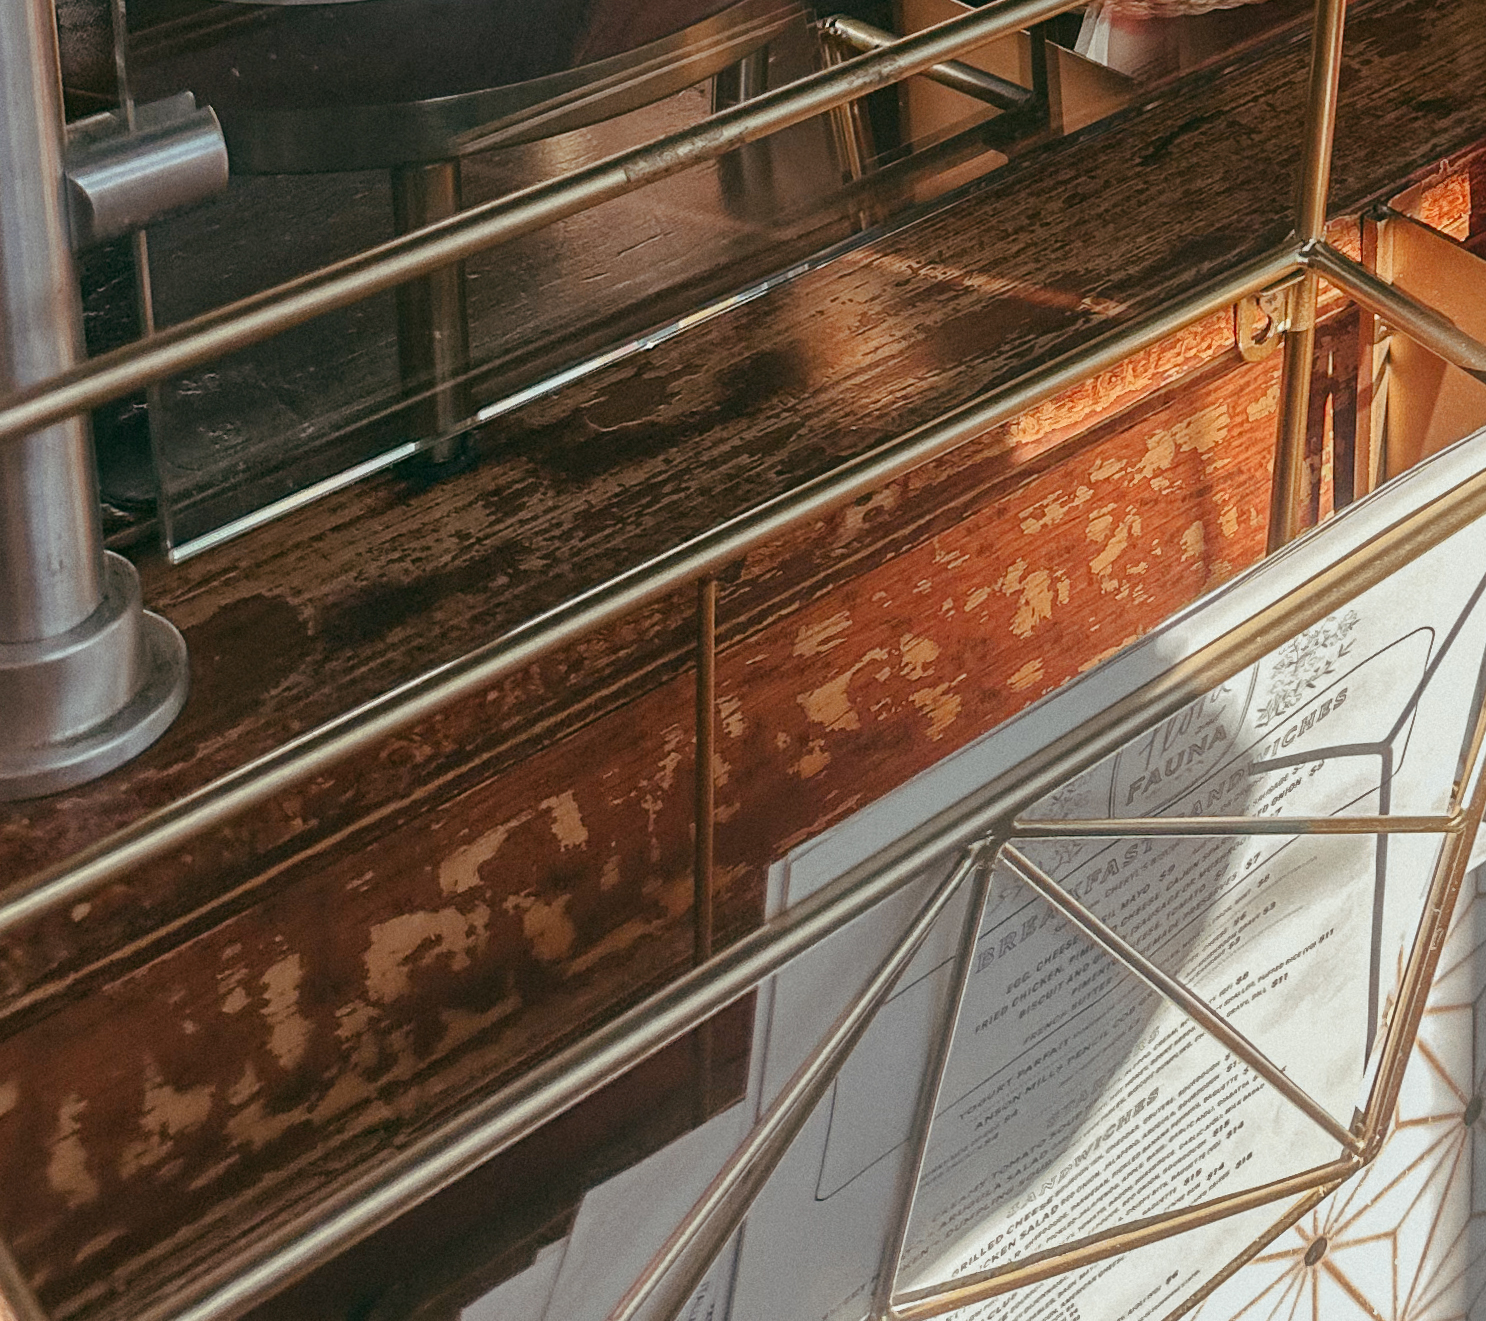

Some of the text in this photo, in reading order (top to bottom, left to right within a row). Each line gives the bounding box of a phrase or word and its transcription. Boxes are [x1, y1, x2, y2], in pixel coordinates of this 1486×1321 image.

[1125, 724, 1228, 806] FAUNA
[1180, 688, 1348, 816] ANDWICHES
[974, 1004, 1008, 1035] FRIED
[1018, 1204, 1059, 1240] SALAD
